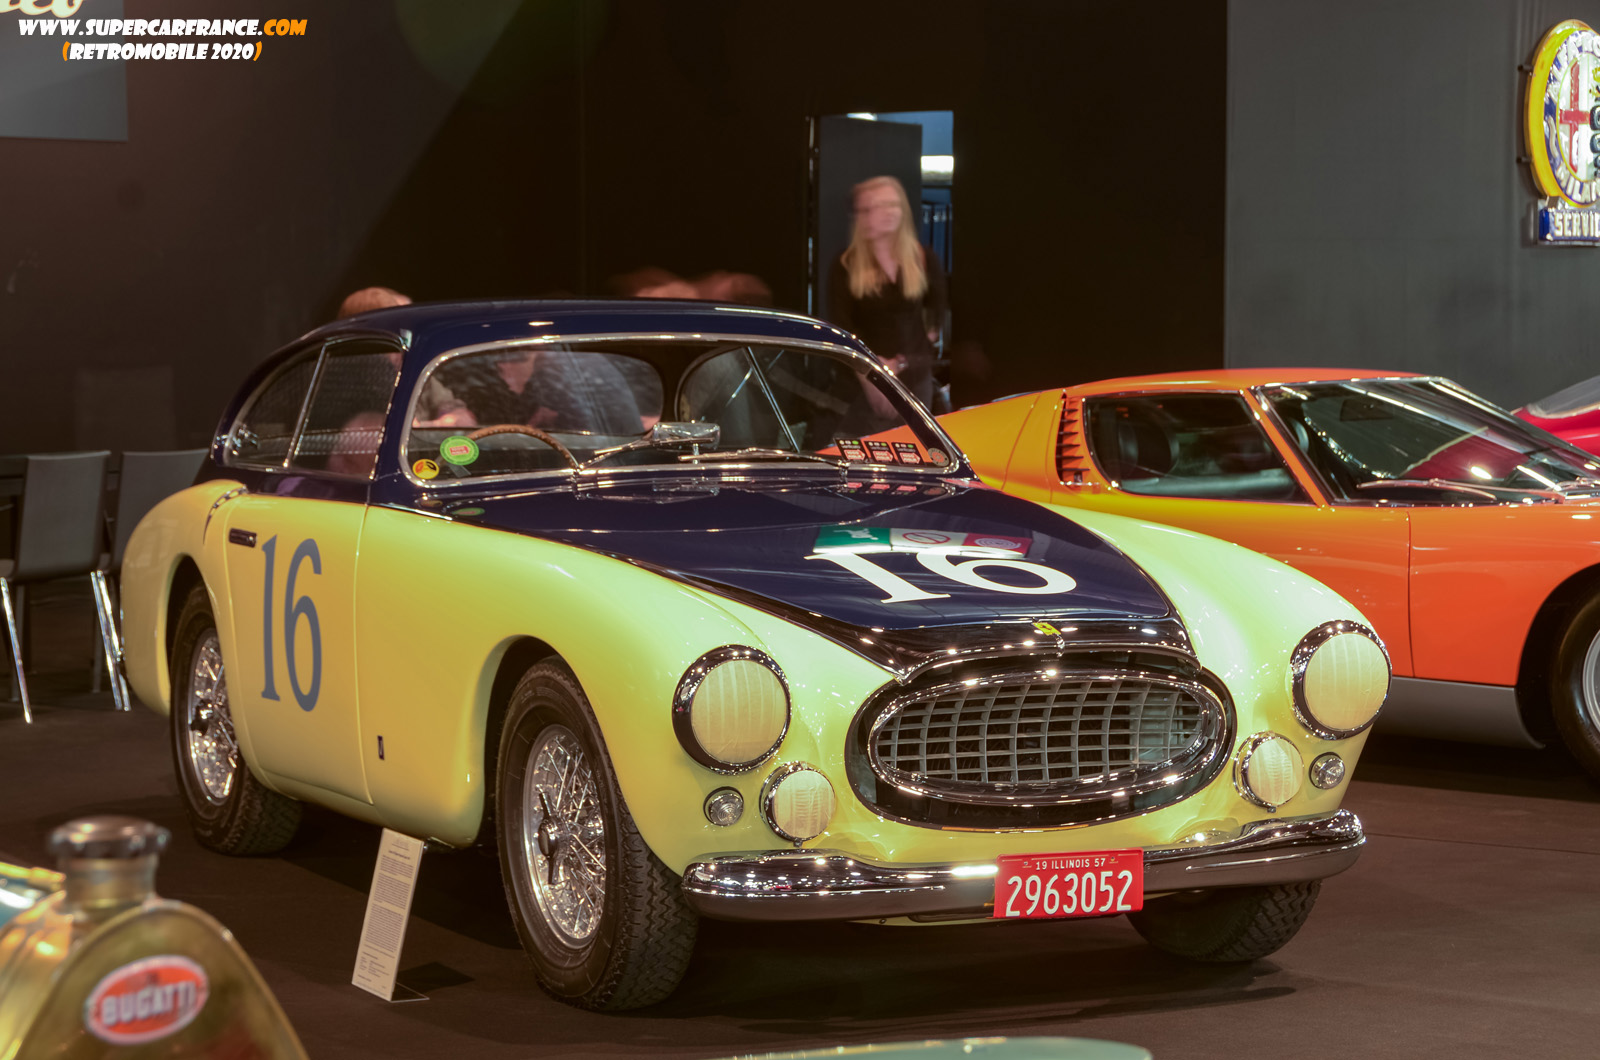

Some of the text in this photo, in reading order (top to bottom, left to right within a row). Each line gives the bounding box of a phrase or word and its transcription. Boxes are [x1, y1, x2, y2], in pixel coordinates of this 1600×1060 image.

[804, 550, 1077, 604] 16
[261, 534, 323, 712] 16
[1035, 857, 1106, 871] 19 ILLINOIS 57
[1005, 869, 1133, 917] 2963052
[102, 980, 197, 1026] BUGATTI
